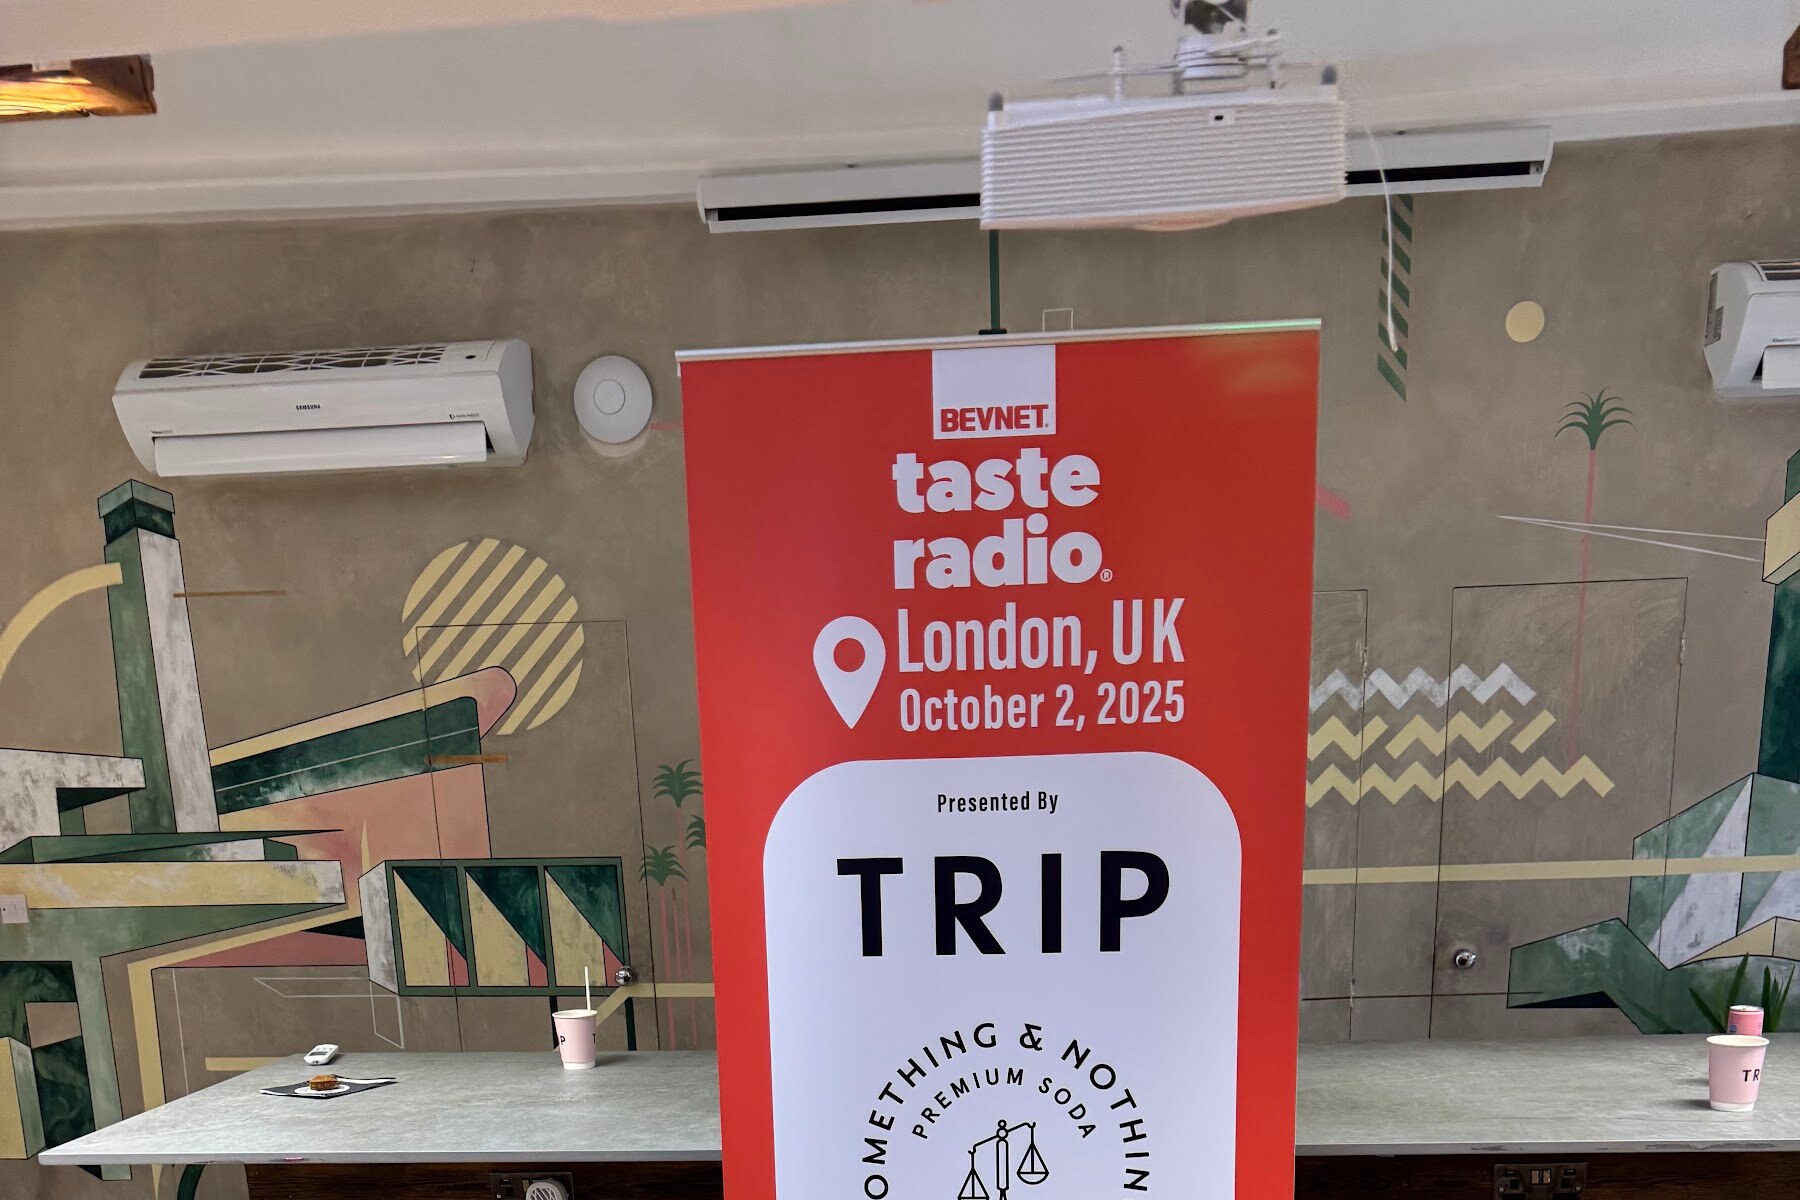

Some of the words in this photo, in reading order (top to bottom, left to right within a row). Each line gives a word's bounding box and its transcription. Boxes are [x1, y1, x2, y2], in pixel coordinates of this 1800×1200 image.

[891, 447, 1101, 514] taste
[897, 601, 1098, 675] London,
[1112, 597, 1186, 666] UK
[899, 684, 1045, 732] October
[1055, 683, 1086, 732] 2,
[1097, 679, 1185, 725] 2025
[937, 790, 1030, 813] Presented
[1038, 791, 1059, 815] By
[836, 850, 1170, 957] TRIP
[1019, 1022, 1043, 1052] &
[911, 1067, 1025, 1140] PREMIUM
[1038, 1076, 1097, 1139] SODA
